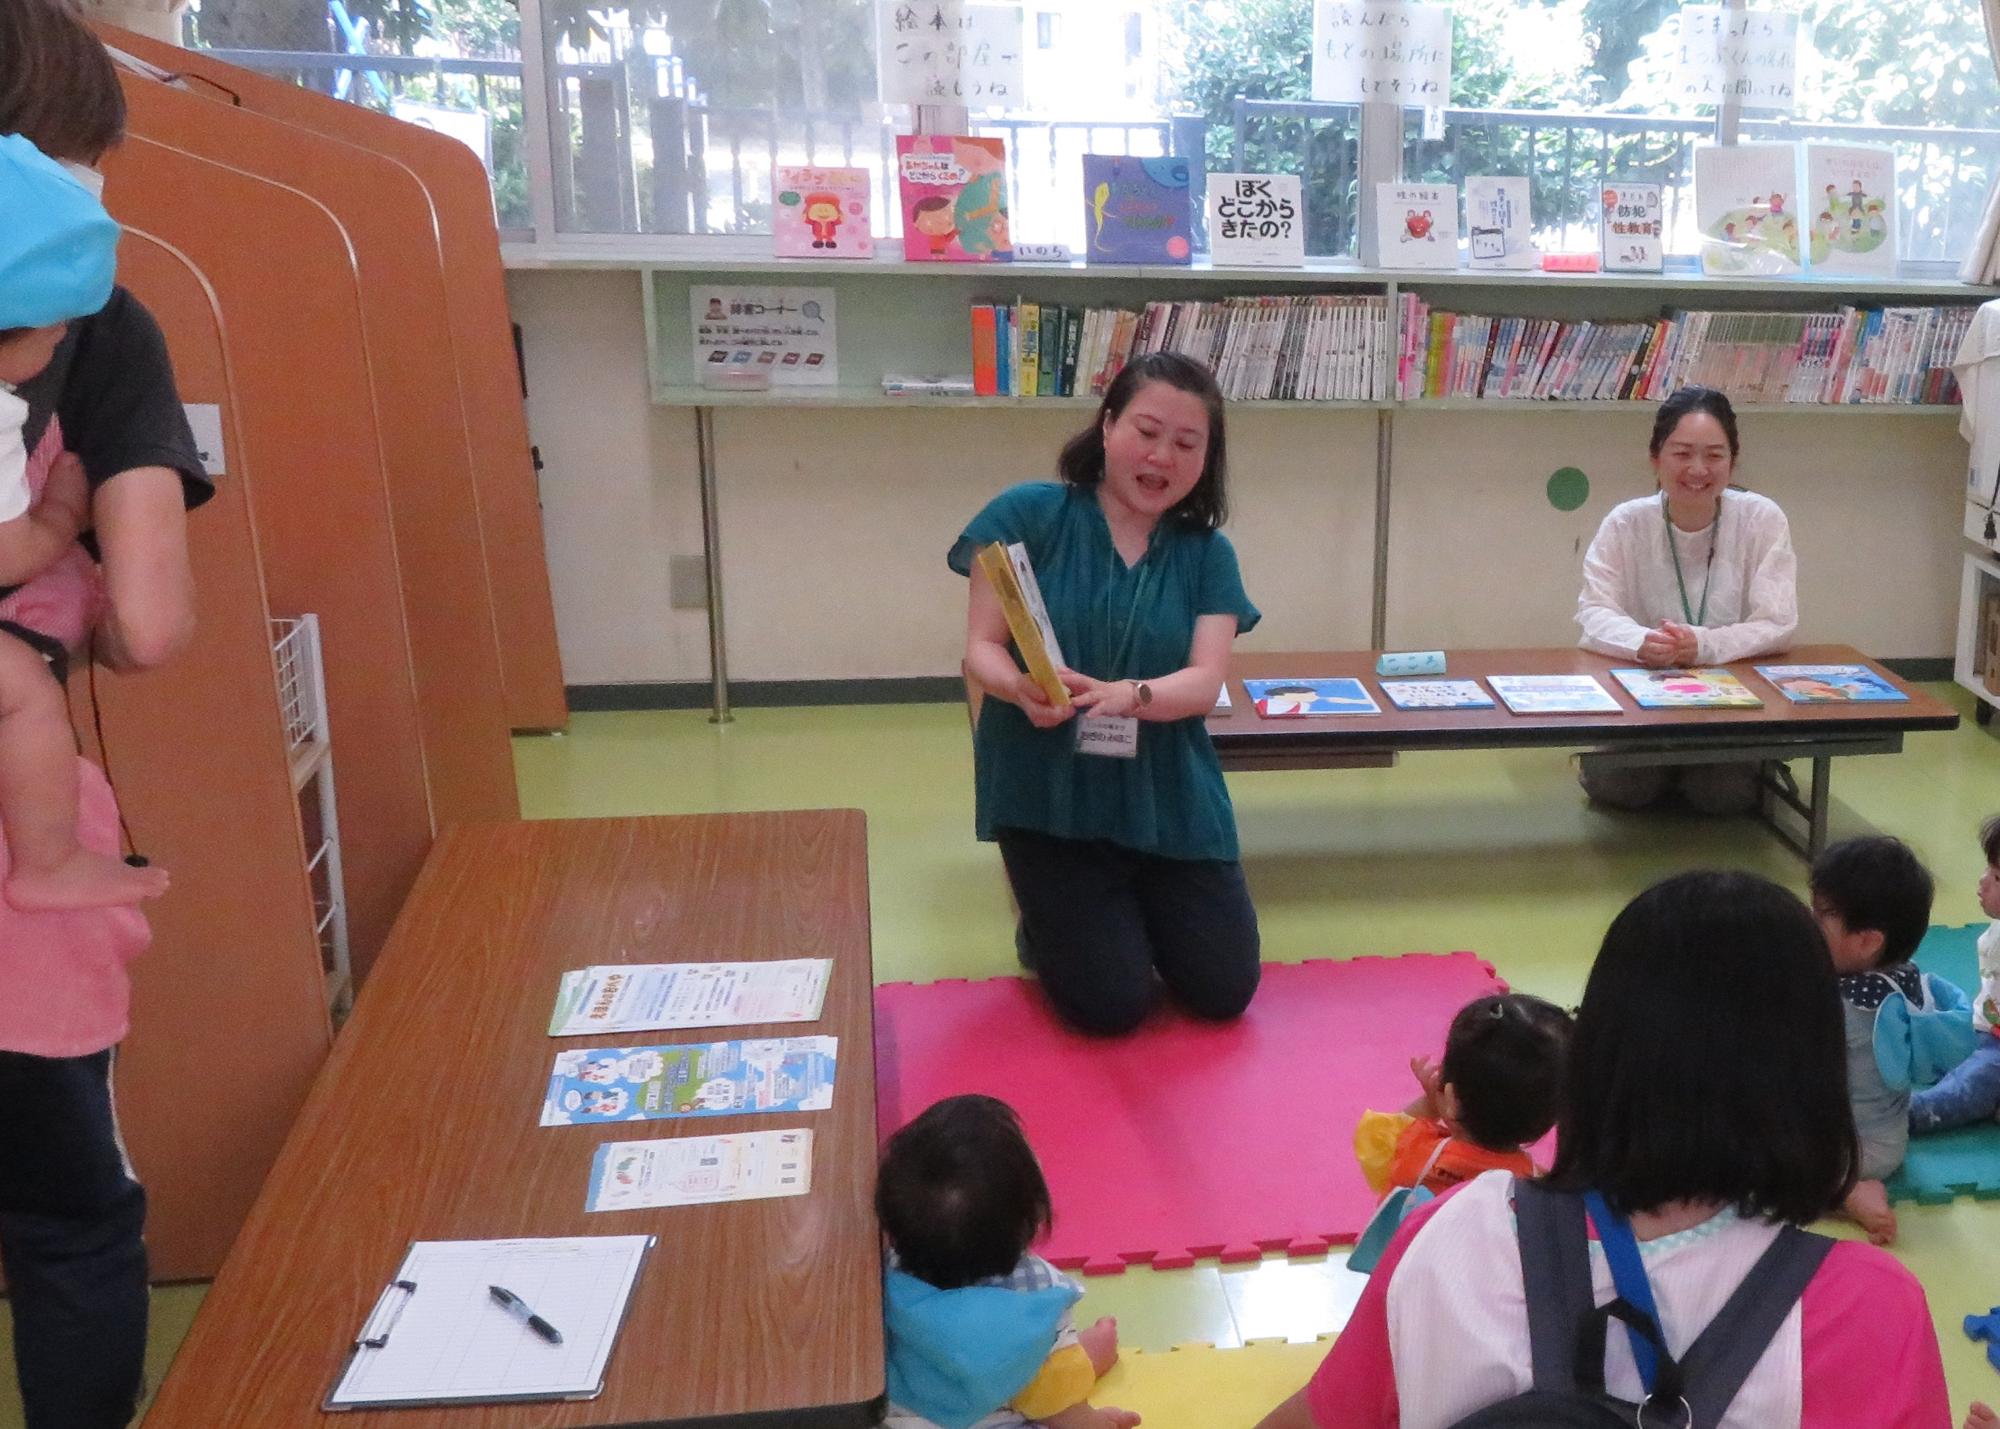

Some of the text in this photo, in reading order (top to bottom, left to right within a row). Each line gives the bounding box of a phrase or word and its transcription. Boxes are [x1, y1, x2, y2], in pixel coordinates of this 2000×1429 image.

[1235, 180, 1272, 198] ぼく
[1218, 196, 1295, 219] どこから
[1618, 205, 1646, 218] 防犯
[1221, 219, 1292, 239] きたの?
[1611, 221, 1652, 234] 性教育
[1019, 246, 1063, 257] いのち
